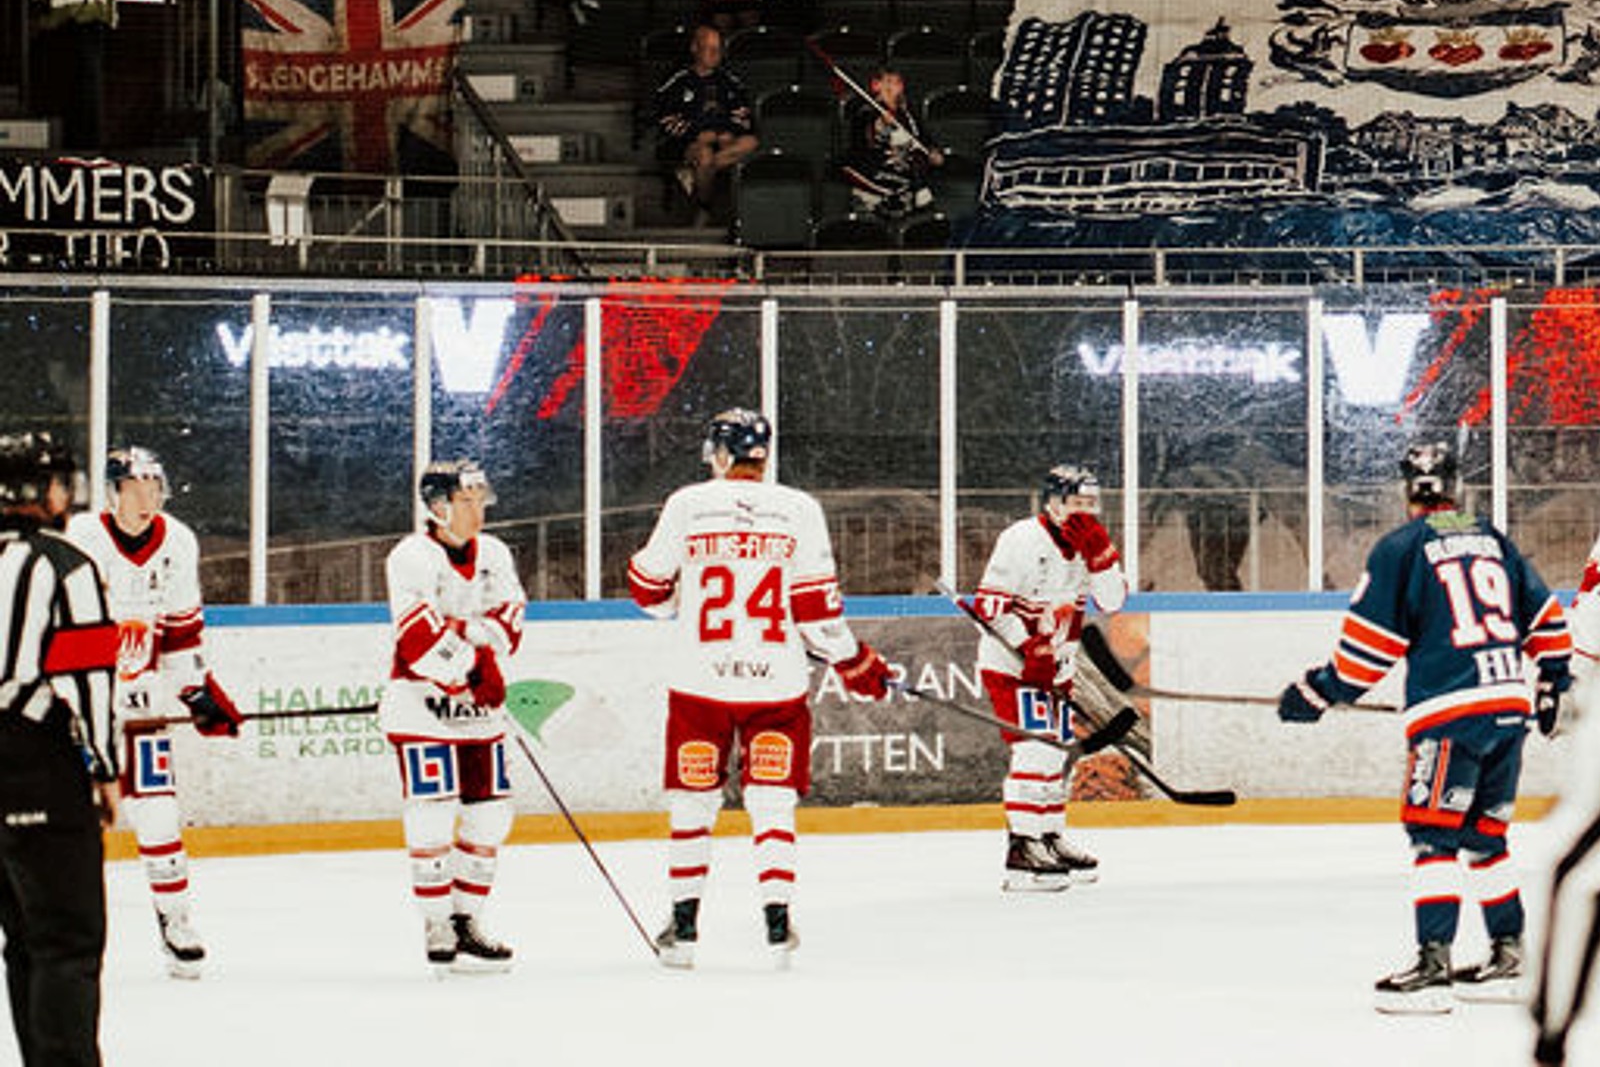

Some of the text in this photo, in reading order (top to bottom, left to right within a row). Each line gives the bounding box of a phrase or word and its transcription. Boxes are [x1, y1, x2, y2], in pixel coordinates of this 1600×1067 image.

[699, 564, 787, 643] 24
[1434, 557, 1518, 649] 19
[806, 663, 983, 703] ARAN
[299, 738, 392, 756] KARO
